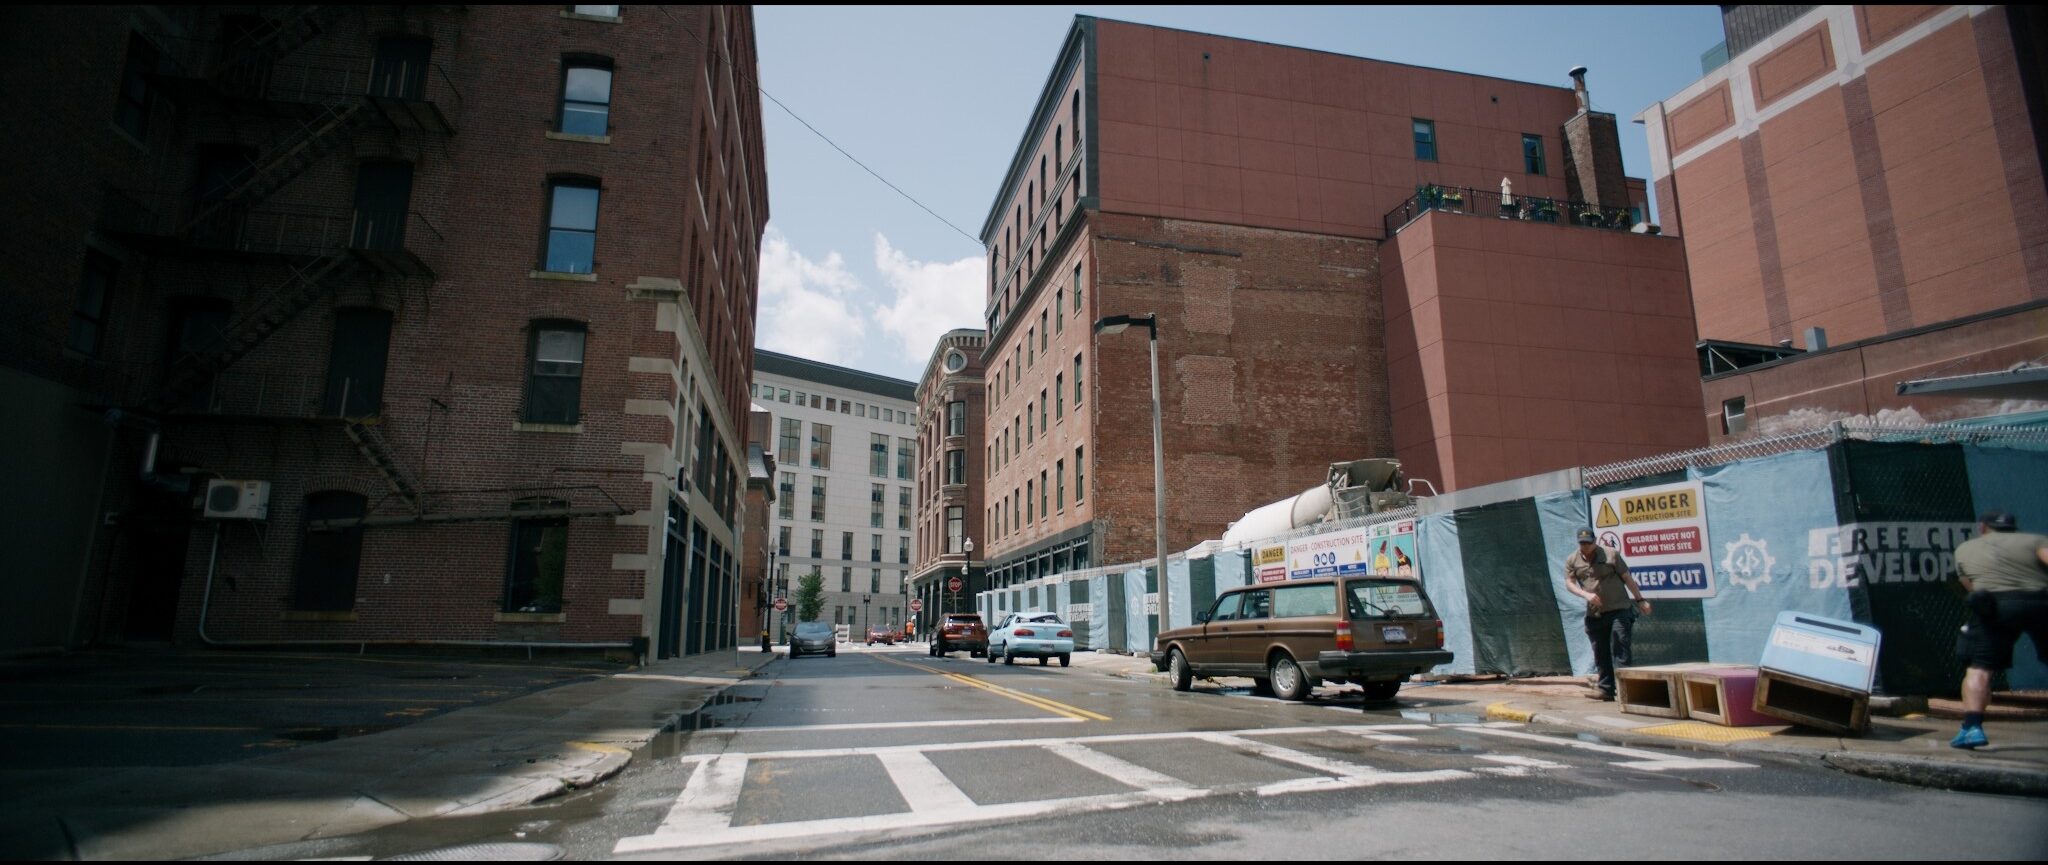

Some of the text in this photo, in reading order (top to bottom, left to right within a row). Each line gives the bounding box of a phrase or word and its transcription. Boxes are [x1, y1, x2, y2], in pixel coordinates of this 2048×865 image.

[1625, 493, 1690, 514] DANGER
[1626, 510, 1691, 523] CONSTRUCTION SITE
[1351, 534, 1364, 544] SITE
[1626, 531, 1696, 544] CHILDREN MUST NOT
[1826, 525, 1973, 553] FREE CIT
[1261, 548, 1284, 559] DANGER
[1631, 542, 1692, 553] PLAY ON THIS SITE
[1809, 551, 1956, 589] DEVELOP
[1631, 569, 1701, 586] KEEP OUT
